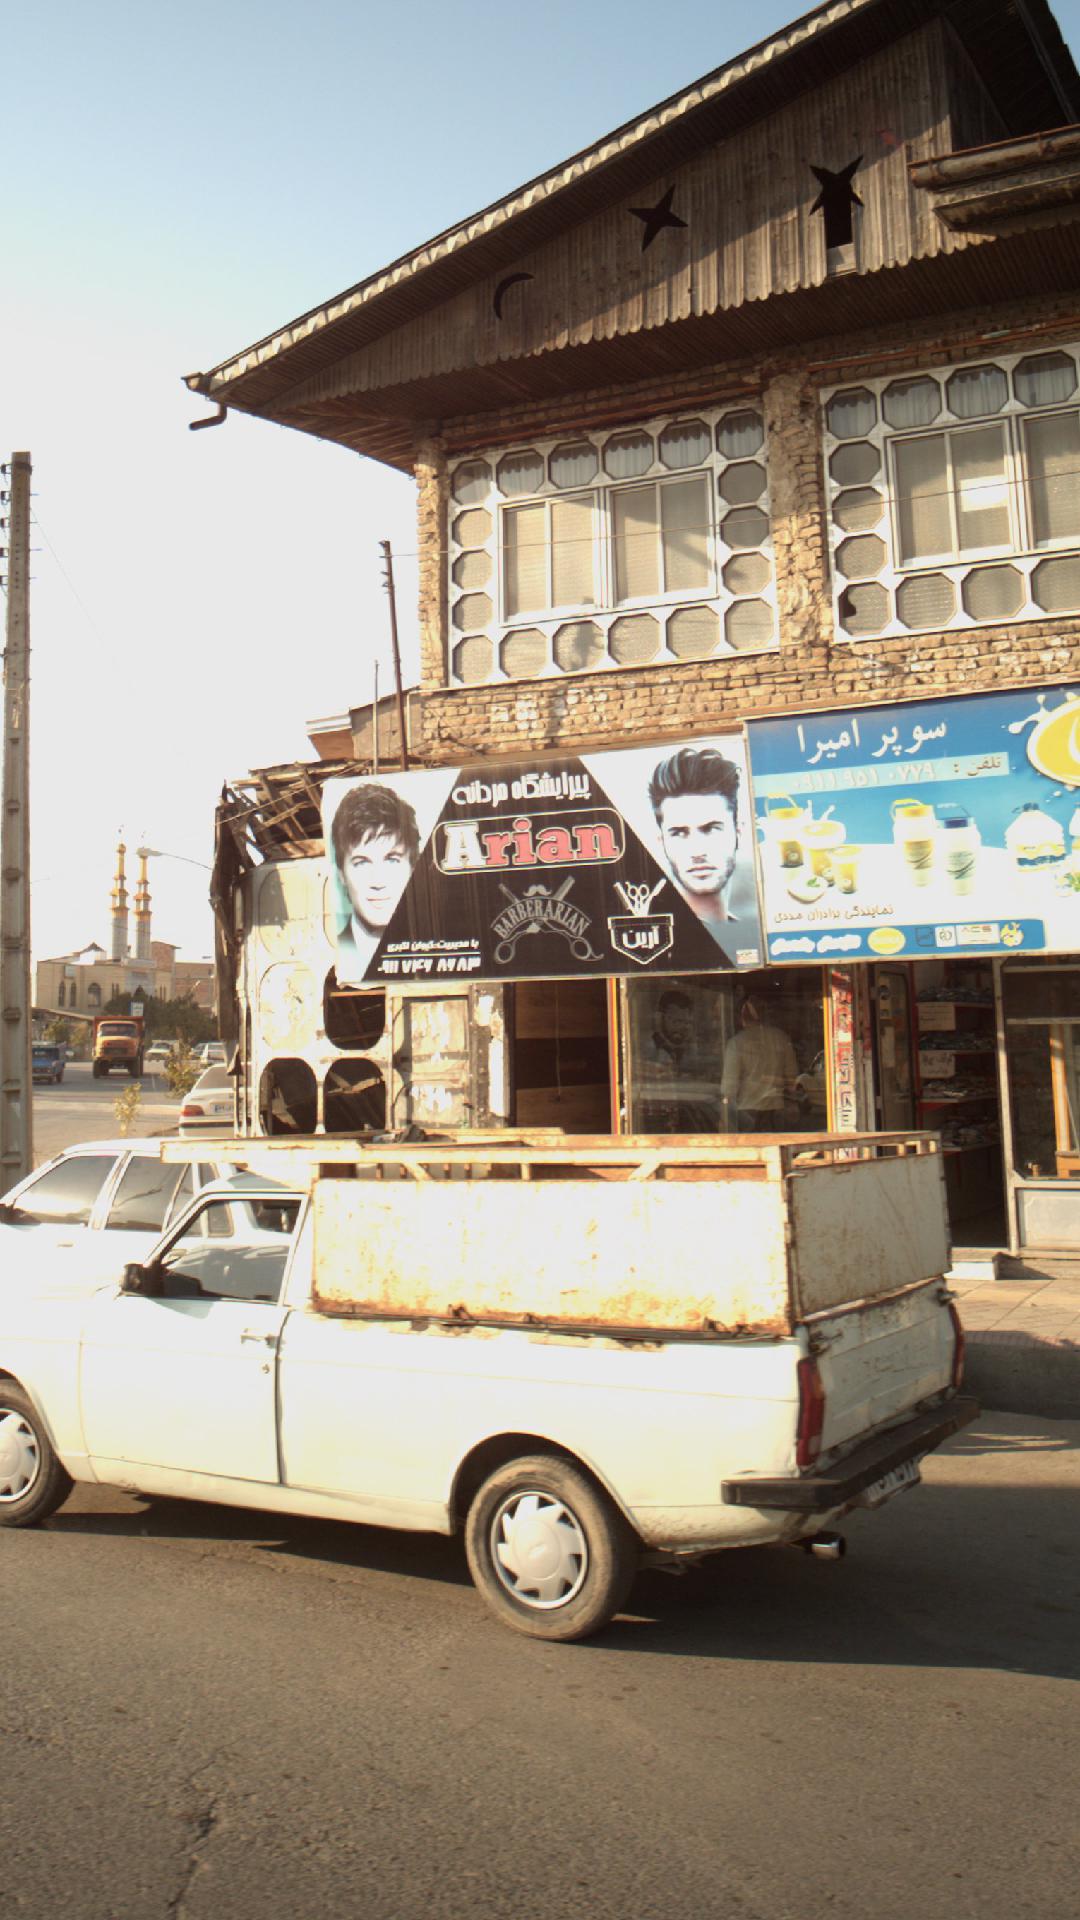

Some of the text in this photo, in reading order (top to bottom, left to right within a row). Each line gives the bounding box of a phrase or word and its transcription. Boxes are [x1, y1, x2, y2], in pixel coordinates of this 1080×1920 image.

[796, 718, 861, 764] امیرا
[451, 771, 592, 808] پیرایشگاه مردانه
[443, 817, 619, 871] Arian
[622, 926, 660, 950] آرین
